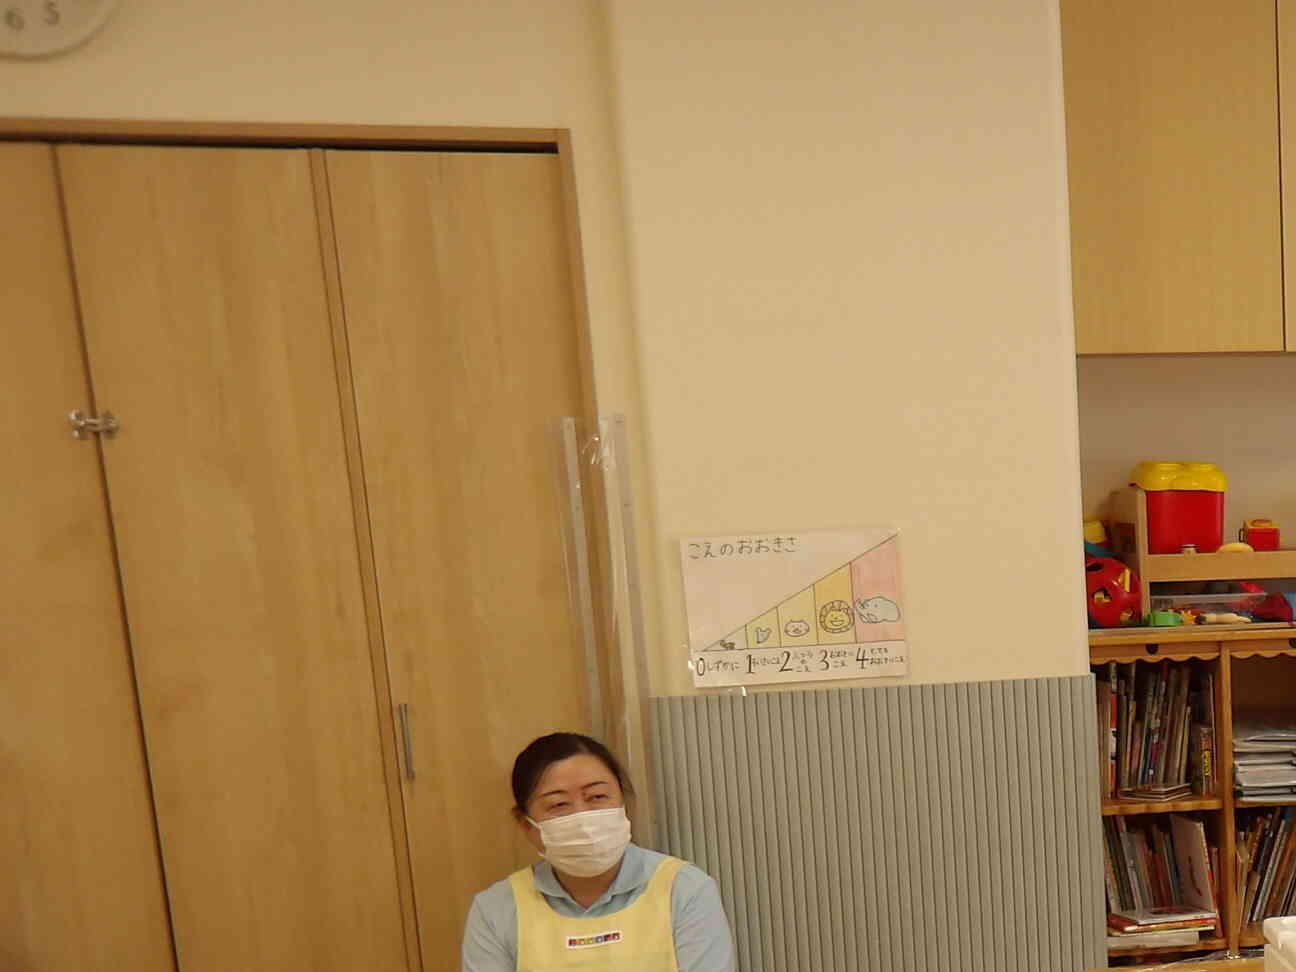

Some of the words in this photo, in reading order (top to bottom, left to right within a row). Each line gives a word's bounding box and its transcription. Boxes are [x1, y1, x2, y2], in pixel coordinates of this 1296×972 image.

[688, 535, 797, 559] こえのおおきさ
[696, 657, 706, 677] 0
[746, 653, 755, 674] 1
[779, 650, 793, 673] 2
[819, 650, 830, 671] 3
[855, 648, 869, 670] 4
